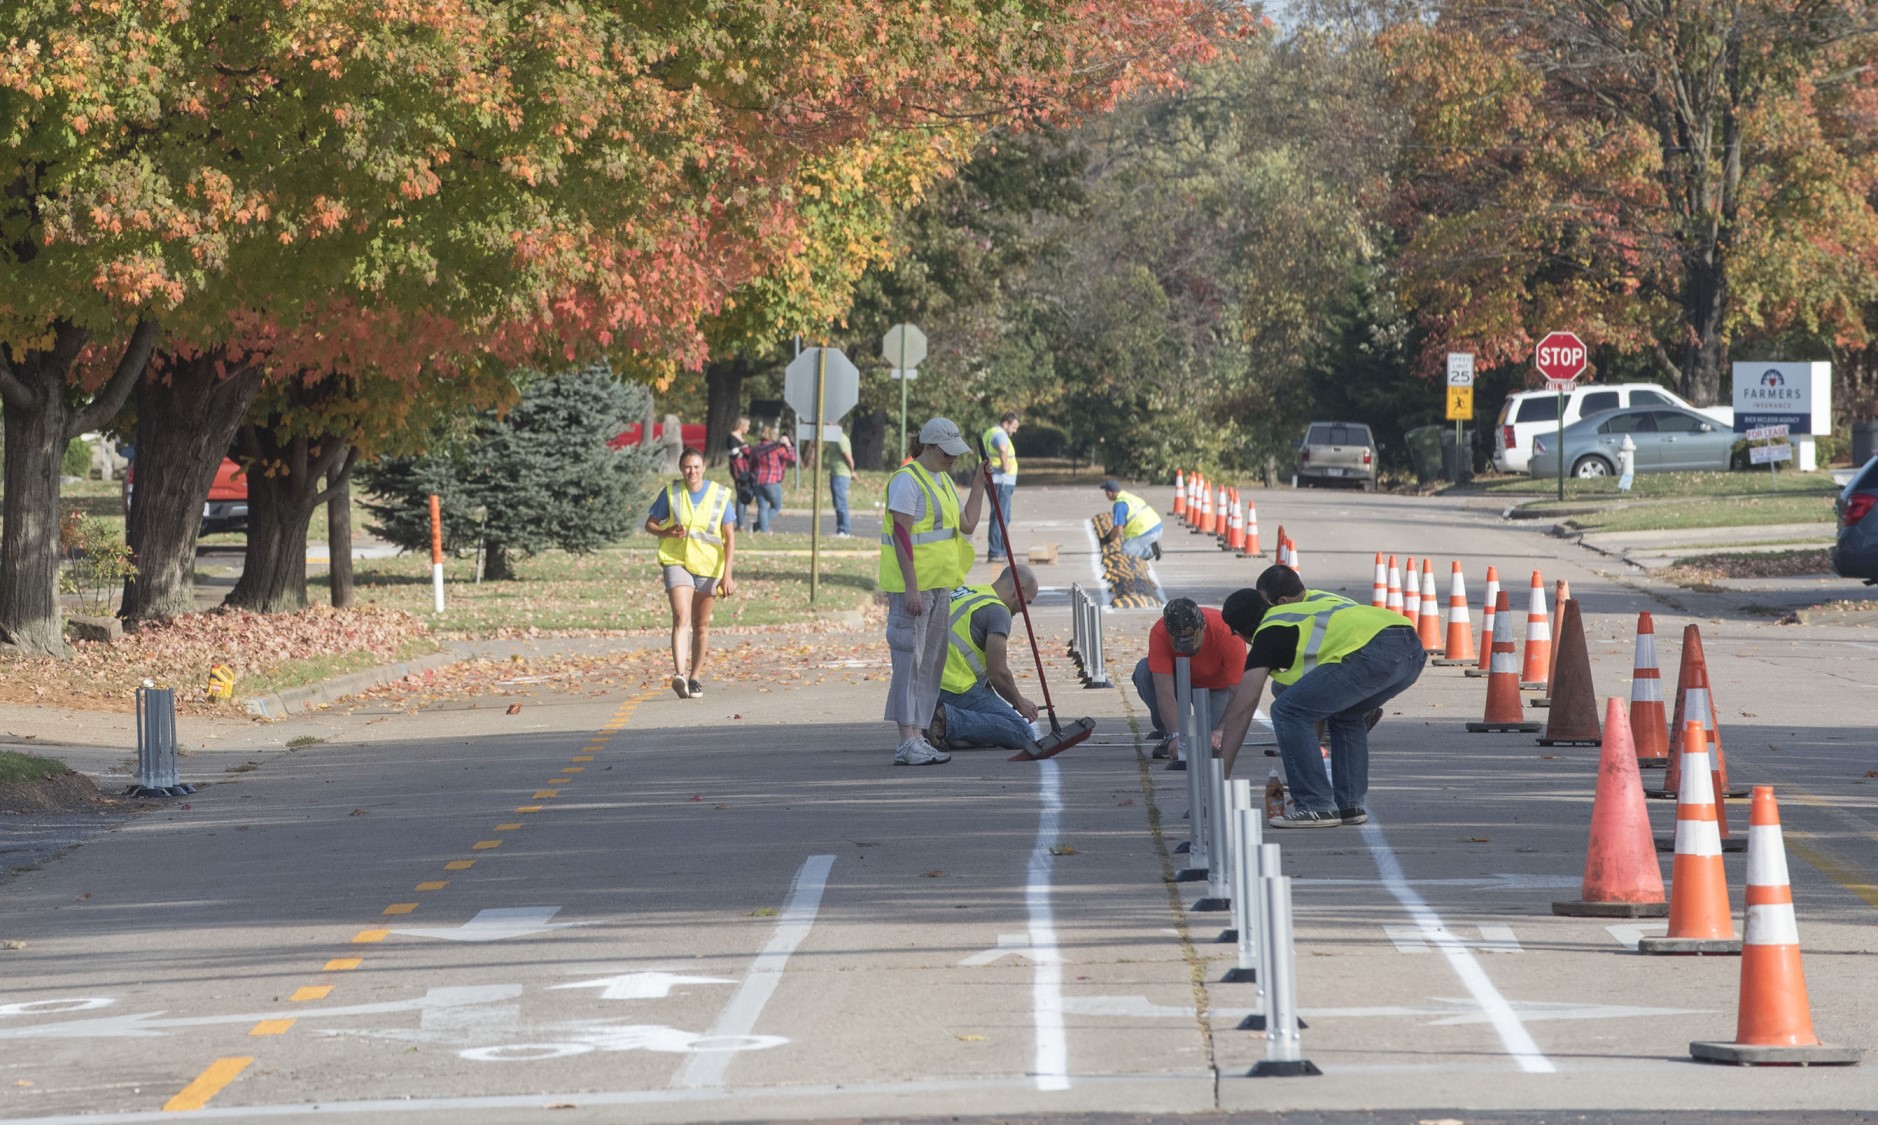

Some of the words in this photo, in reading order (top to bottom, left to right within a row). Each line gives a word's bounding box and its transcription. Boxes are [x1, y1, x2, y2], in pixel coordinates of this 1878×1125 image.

[1540, 347, 1583, 366] STOP
[1451, 371, 1470, 382] 25
[1548, 382, 1559, 391] ALL
[1562, 382, 1574, 391] WAY
[1744, 389, 1801, 399] FARMERS
[1747, 431, 1761, 440] FOR
[1764, 427, 1786, 437] LEASE
